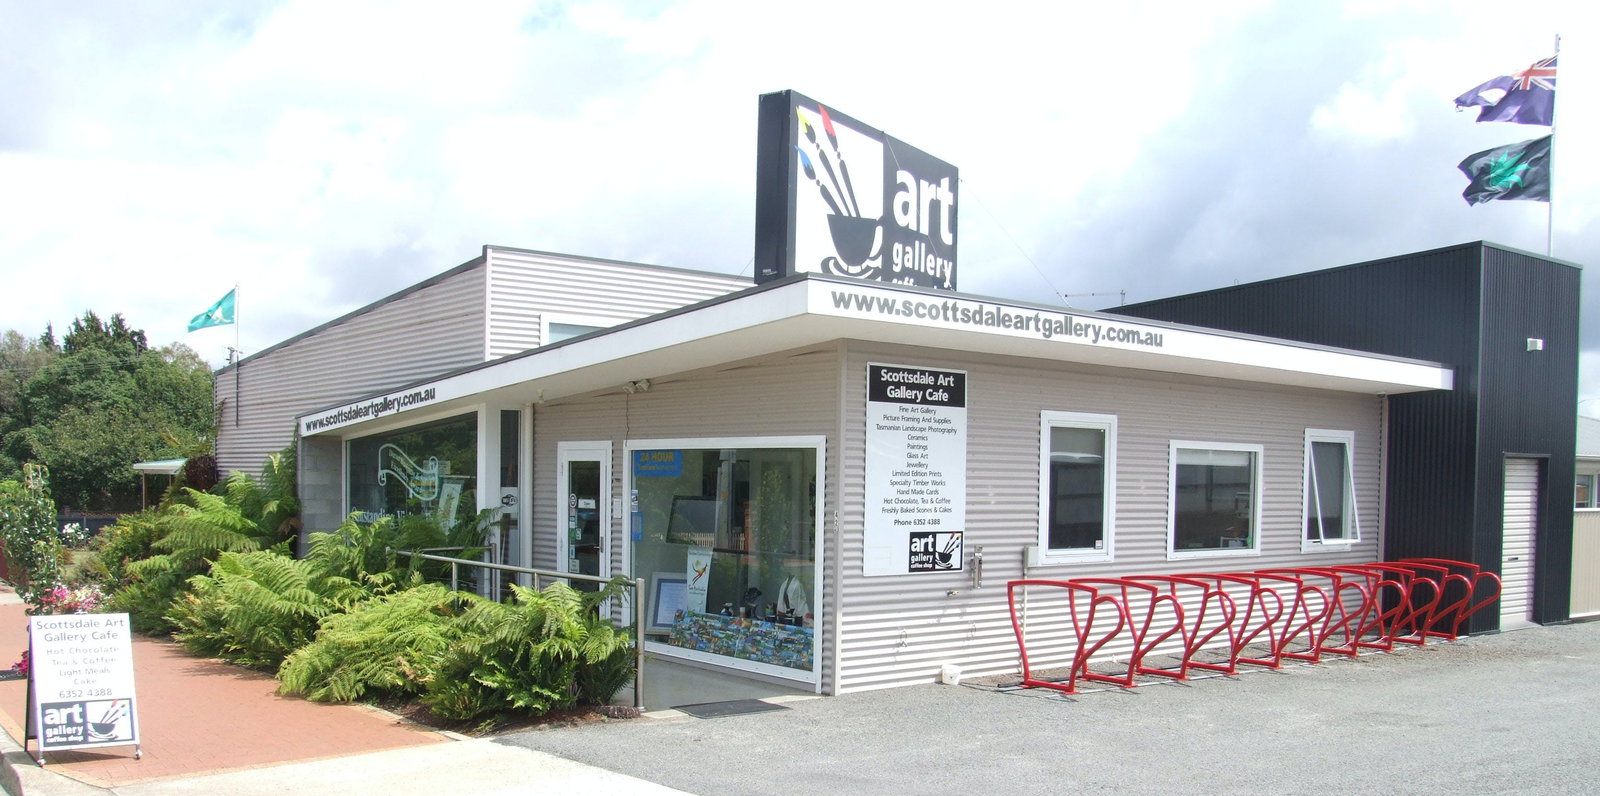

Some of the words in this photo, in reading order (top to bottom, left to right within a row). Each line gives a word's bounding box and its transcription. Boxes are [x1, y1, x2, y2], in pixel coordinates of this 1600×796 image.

[893, 170, 954, 246] art
[892, 240, 952, 288] gallery
[831, 290, 1163, 348] www.scottsdaleartgallery.com.au
[880, 369, 934, 385] Scottsdale
[937, 374, 954, 386] Art
[887, 386, 923, 402] Gallery
[926, 389, 948, 402] Cafe
[306, 388, 436, 432] www.scottsdaleartgallery.com.au
[920, 407, 936, 415] Gallery
[901, 416, 920, 424] Framing
[928, 427, 957, 435] Photography
[911, 534, 934, 552] art
[911, 553, 933, 564] gallery
[36, 619, 100, 630] Scottsdale
[105, 618, 124, 627] Art
[44, 632, 87, 642] Gallery
[91, 630, 119, 640] Cafe
[69, 646, 119, 655] Chocolate
[59, 669, 82, 677] Light
[59, 690, 83, 698] 6352
[87, 688, 112, 697] 4388
[44, 704, 83, 724] art
[46, 725, 83, 737] gallery
